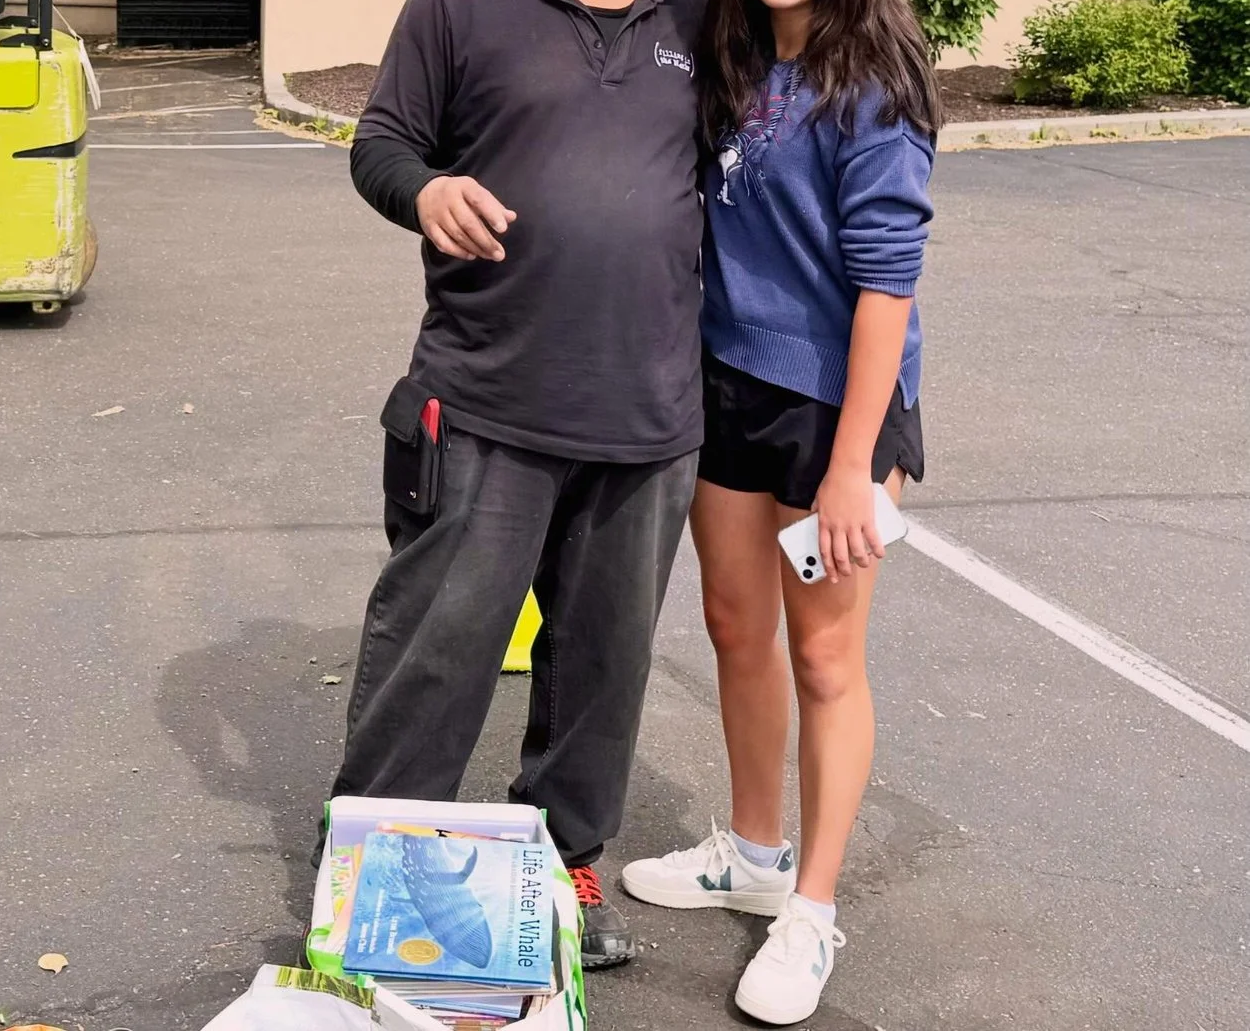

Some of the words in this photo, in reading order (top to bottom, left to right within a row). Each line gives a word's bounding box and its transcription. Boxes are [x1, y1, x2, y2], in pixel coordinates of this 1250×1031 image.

[522, 849, 543, 875] Life
[520, 878, 542, 916] After
[518, 919, 541, 968] Whale
